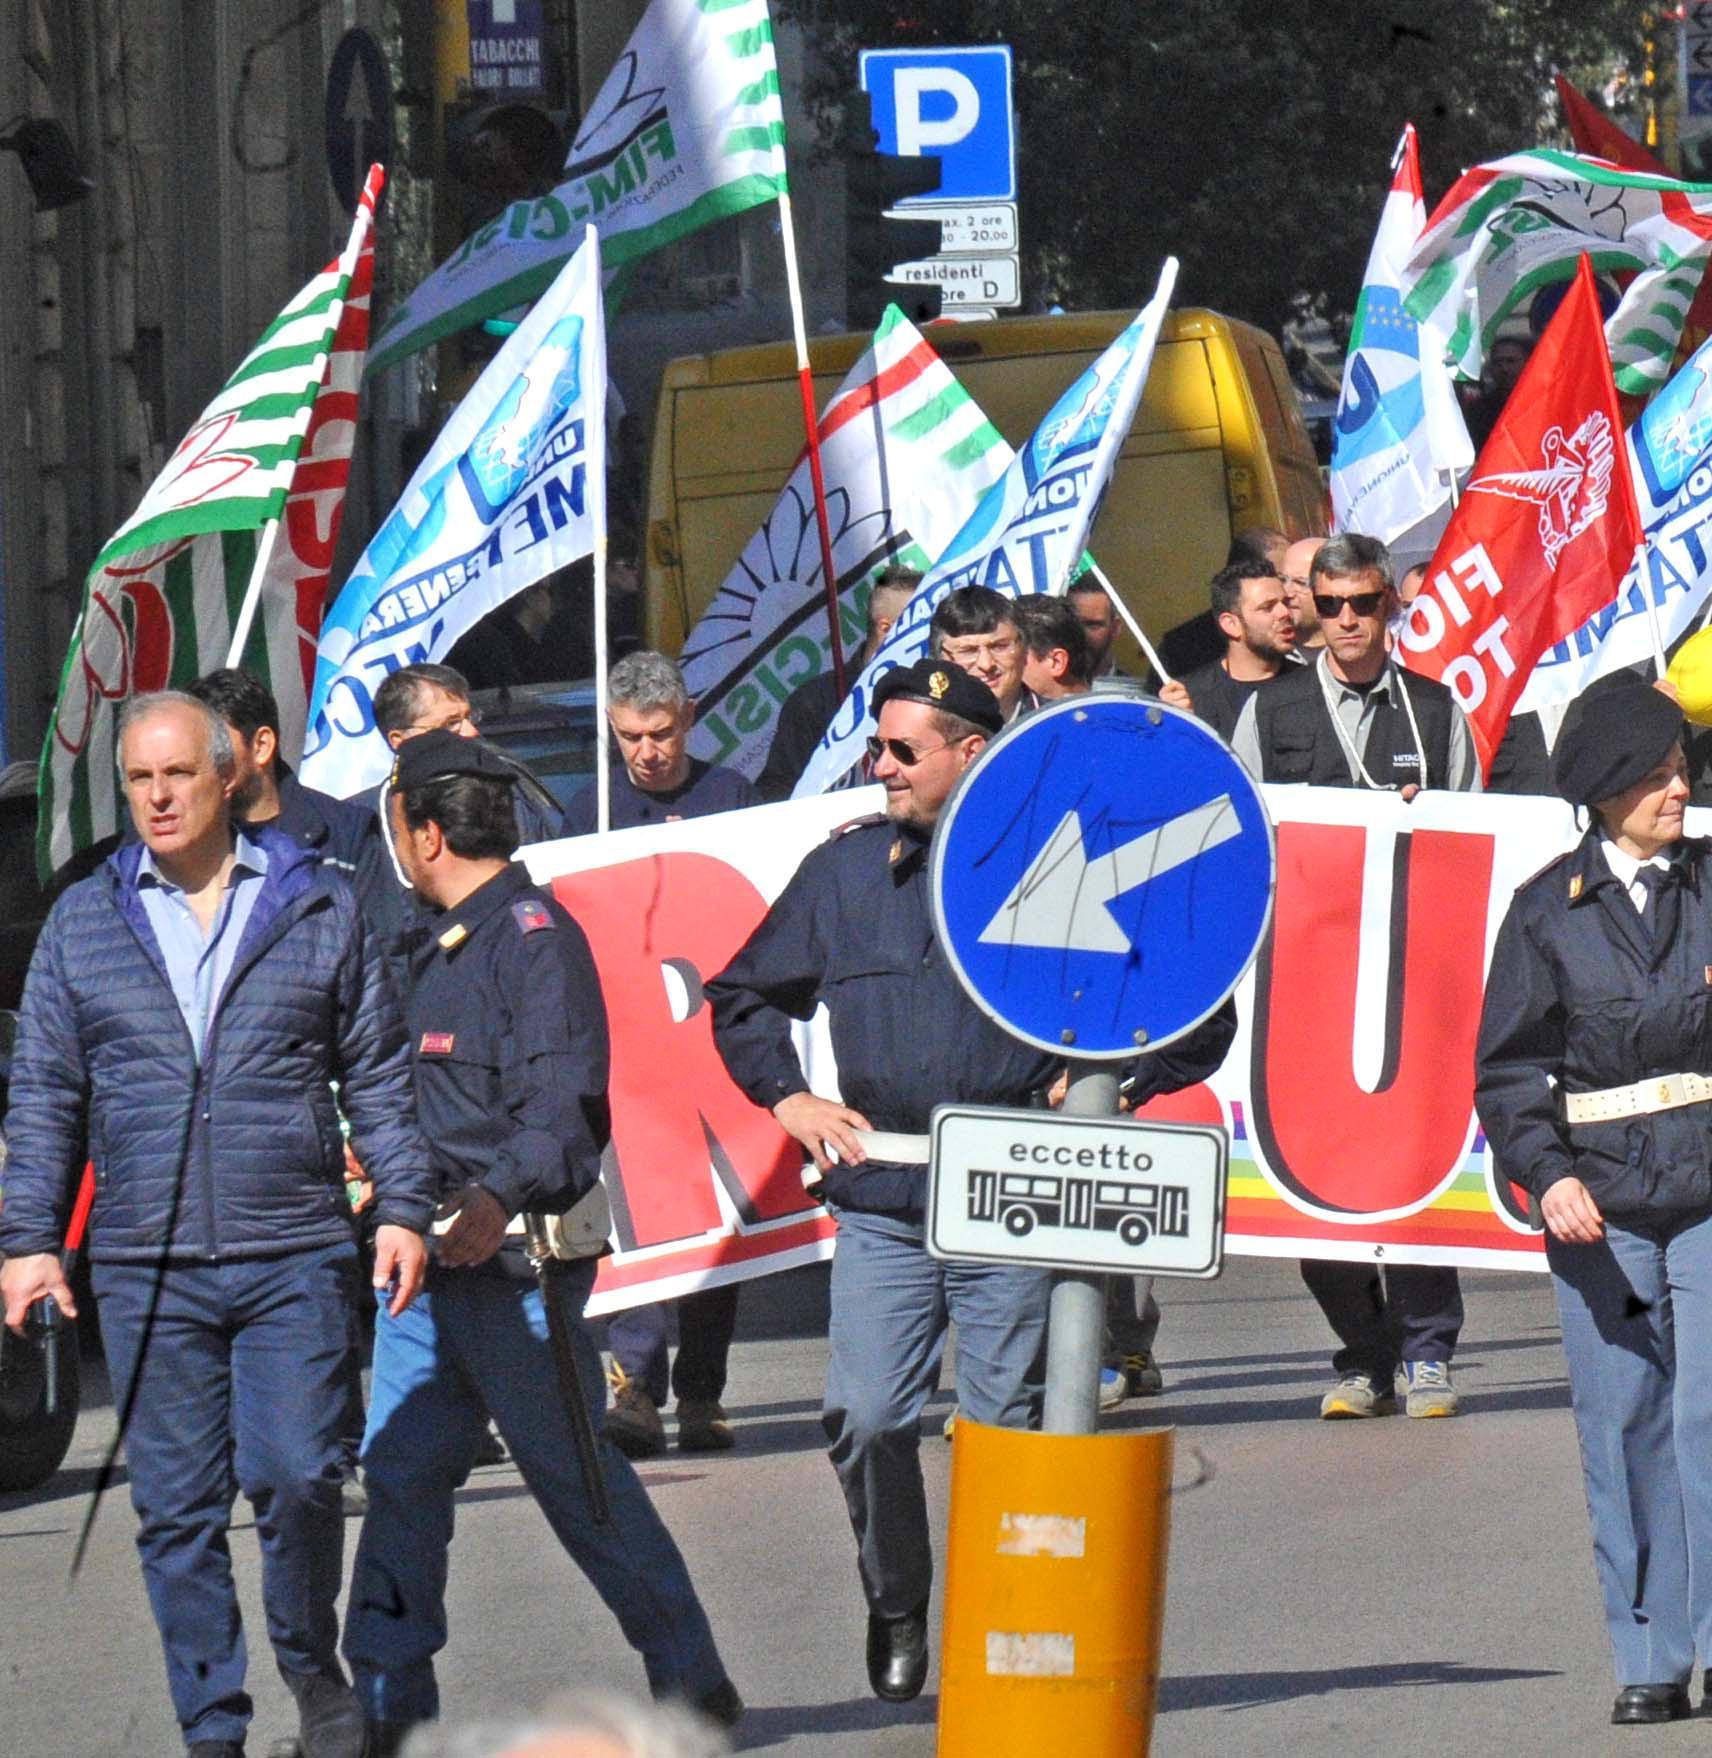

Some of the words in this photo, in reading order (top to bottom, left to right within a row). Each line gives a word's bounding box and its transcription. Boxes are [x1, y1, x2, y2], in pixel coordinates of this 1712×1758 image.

[471, 38, 540, 63] TABACCHI
[893, 67, 980, 157] P
[943, 216, 963, 228] ax.
[967, 216, 976, 227] 2
[981, 216, 1003, 227] ore
[906, 264, 983, 281] residenti
[983, 280, 999, 299] D
[1009, 1140, 1153, 1172] eccetto
